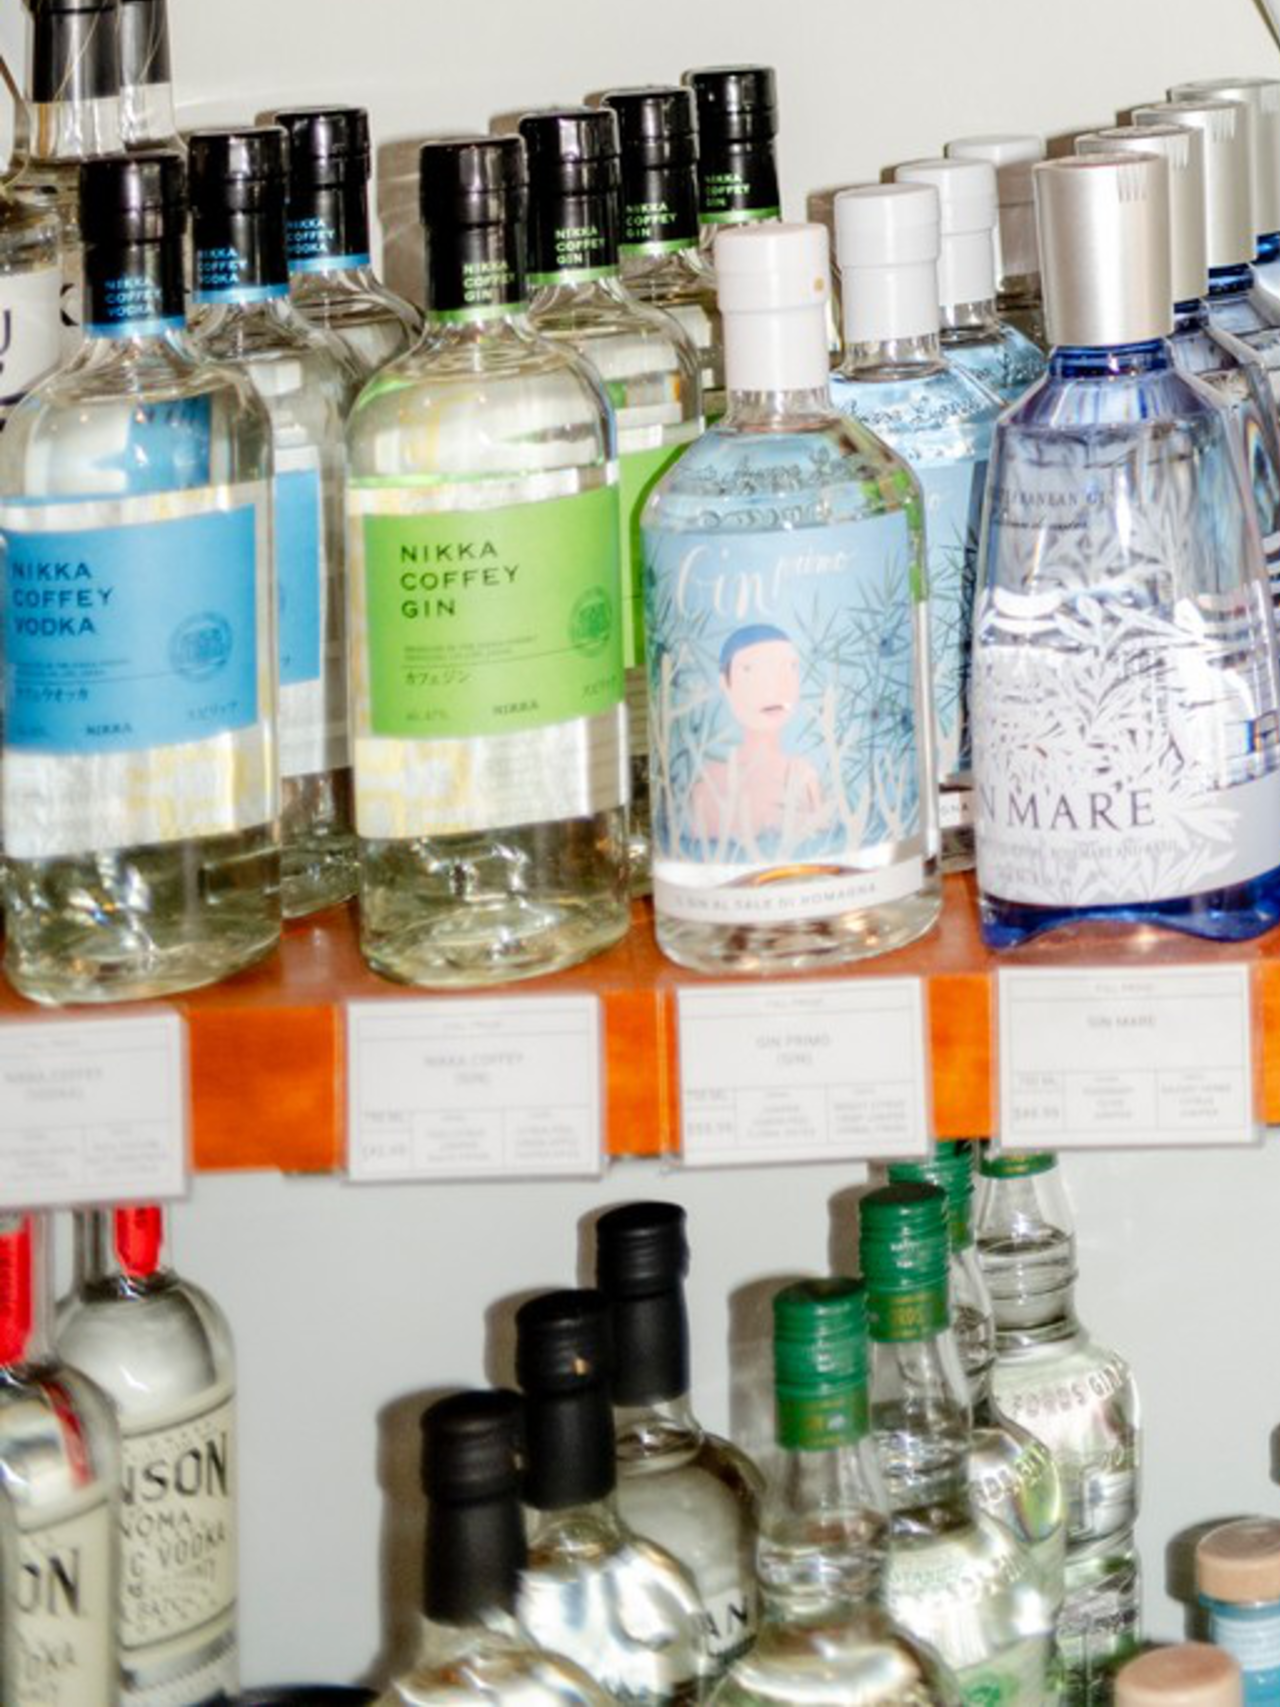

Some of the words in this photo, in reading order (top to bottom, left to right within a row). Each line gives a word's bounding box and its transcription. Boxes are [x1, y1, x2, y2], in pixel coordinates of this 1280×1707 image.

[400, 541, 499, 563] NIKKA
[12, 561, 92, 582] NIKKA
[400, 565, 519, 591] COFFEY
[11, 587, 114, 609] COFFEY
[401, 599, 456, 619] GIN
[13, 616, 97, 637] VODKA
[1008, 789, 1155, 832] MARE
